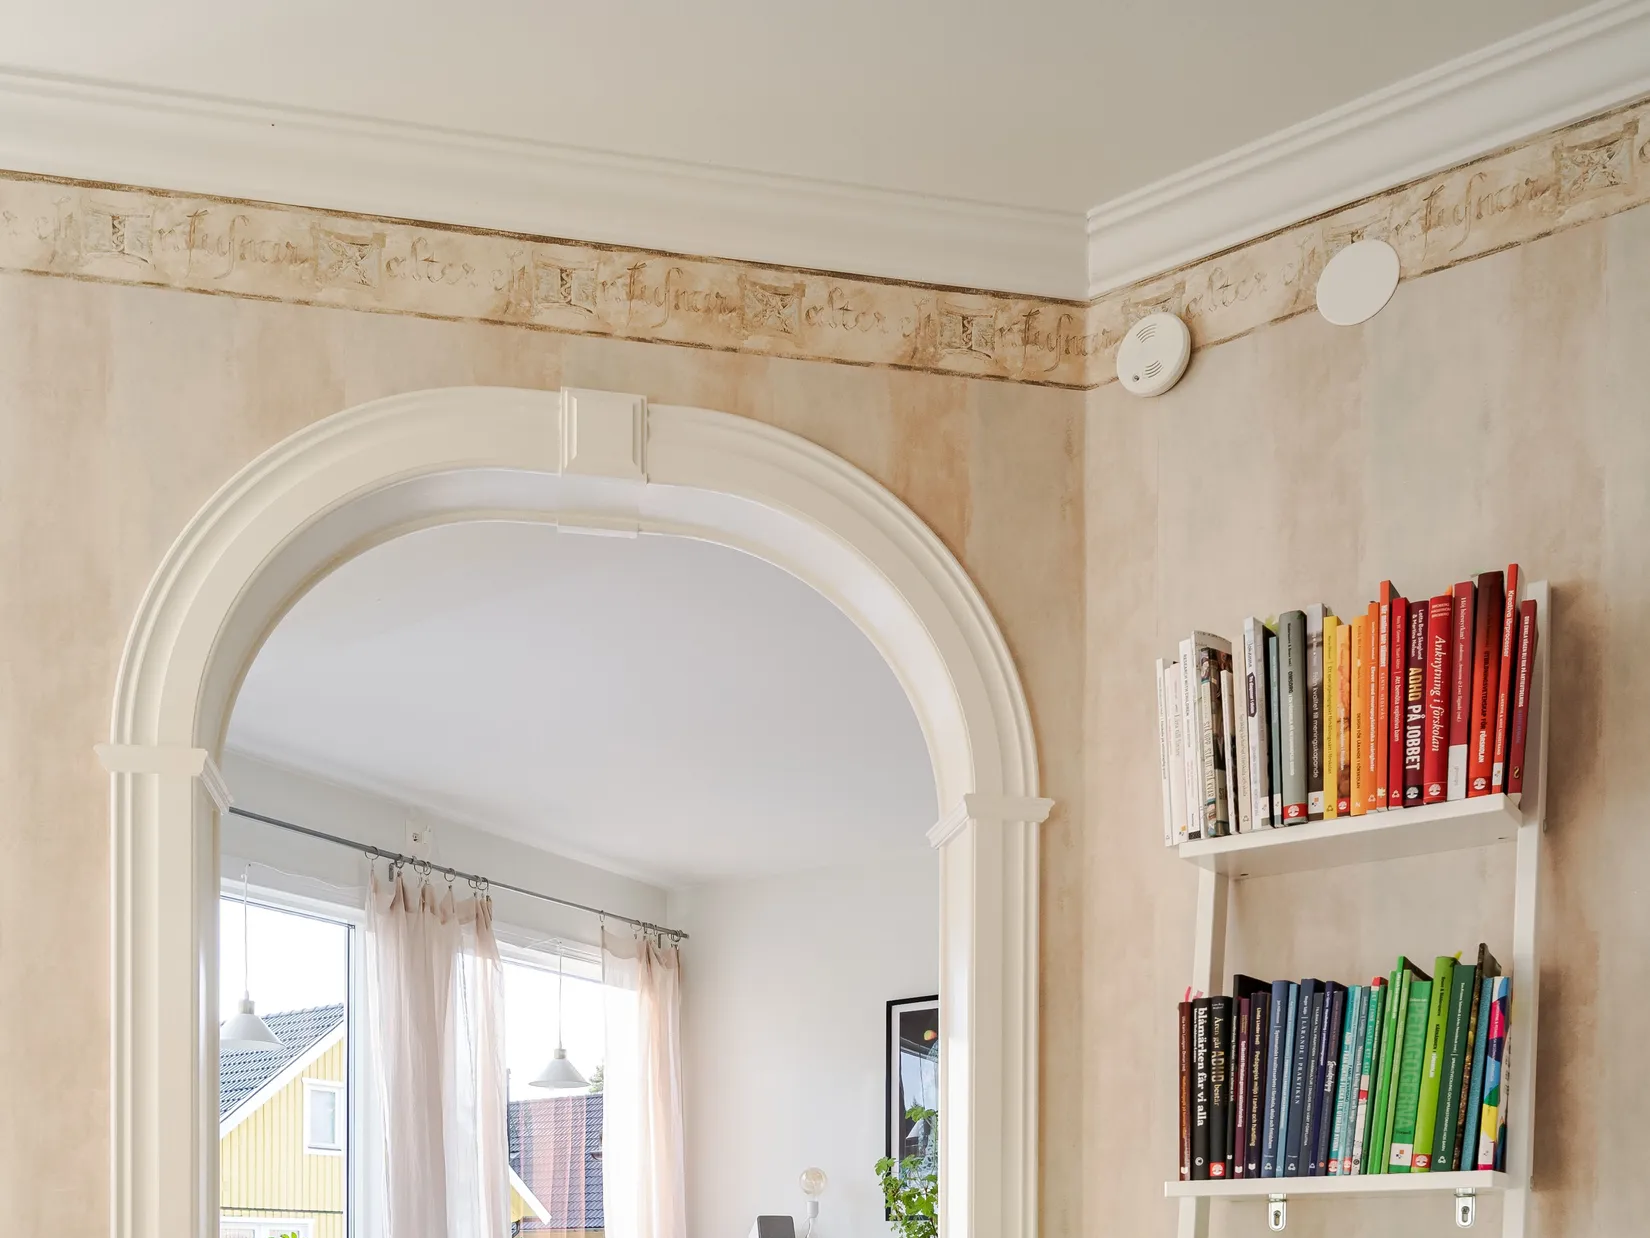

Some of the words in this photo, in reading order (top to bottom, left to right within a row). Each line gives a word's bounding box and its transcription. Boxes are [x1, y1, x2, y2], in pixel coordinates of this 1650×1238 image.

[1506, 589, 1515, 618] Kreativa
[1416, 624, 1424, 636] Borg
[1504, 618, 1513, 658] lärprocesser
[1430, 636, 1447, 698] Anknytning
[1408, 668, 1423, 702] ADHD
[1481, 650, 1490, 717] UTBILDNINGSVETENSKAP
[1518, 673, 1527, 708] AKTIEUTDELNING
[1393, 705, 1401, 729] explosiva
[1407, 704, 1426, 722] PÅ
[1430, 704, 1445, 752] förskolan
[1480, 718, 1488, 730] FÖR
[1311, 720, 1319, 778] meningsskapande
[1406, 725, 1421, 770] JOBBET
[1478, 730, 1487, 763] FÖRSKOLAN
[1197, 1007, 1208, 1070] blåmärken
[1214, 1017, 1224, 1035] Åren
[1299, 1020, 1307, 1054] LÄRANDE
[1213, 1037, 1221, 1049] går
[1212, 1050, 1225, 1083] ADHD
[1252, 1050, 1261, 1081] Pedagogisk
[1271, 1057, 1279, 1088] kvalitetsarbete
[1395, 1002, 1428, 1129] PEDAGOGERNA
[1448, 1057, 1456, 1092] SPRÅKUTVECKLING
[1197, 1072, 1208, 1090] får
[1213, 1084, 1222, 1106] består
[1252, 1081, 1260, 1095] miljö
[1294, 1062, 1304, 1105] PRAKTIKEN
[1338, 1082, 1346, 1100] FLICKA
[1197, 1092, 1207, 1103] vi
[1337, 1100, 1345, 1110] TILL
[1197, 1105, 1207, 1127] alla
[1334, 1110, 1343, 1133] UTBRÄND
[1249, 1123, 1258, 1146] handling
[1332, 1133, 1340, 1152] KVINNA
